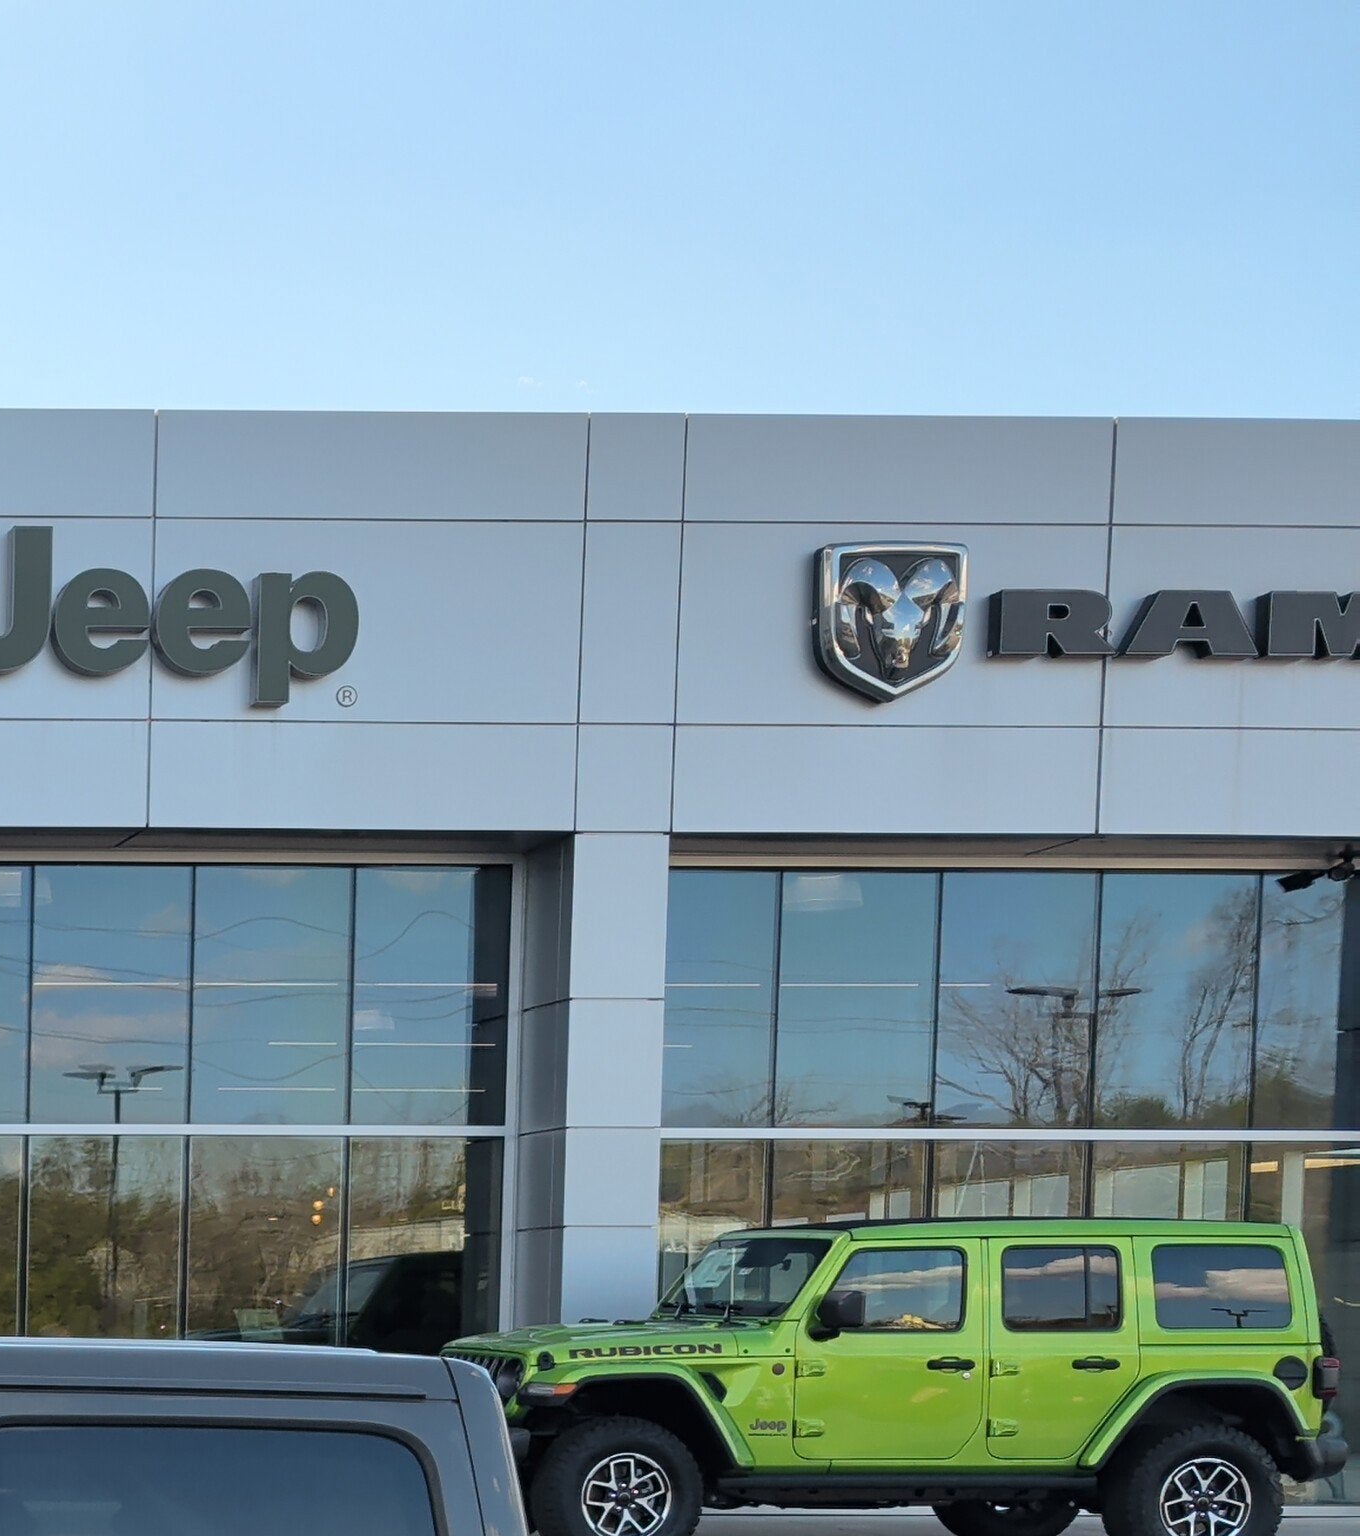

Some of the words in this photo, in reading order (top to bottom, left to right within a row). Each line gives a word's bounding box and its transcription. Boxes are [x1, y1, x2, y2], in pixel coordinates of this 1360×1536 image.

[986, 588, 1360, 660] RAM
[569, 1343, 723, 1359] RUBICON
[749, 1418, 788, 1432] Jeep
